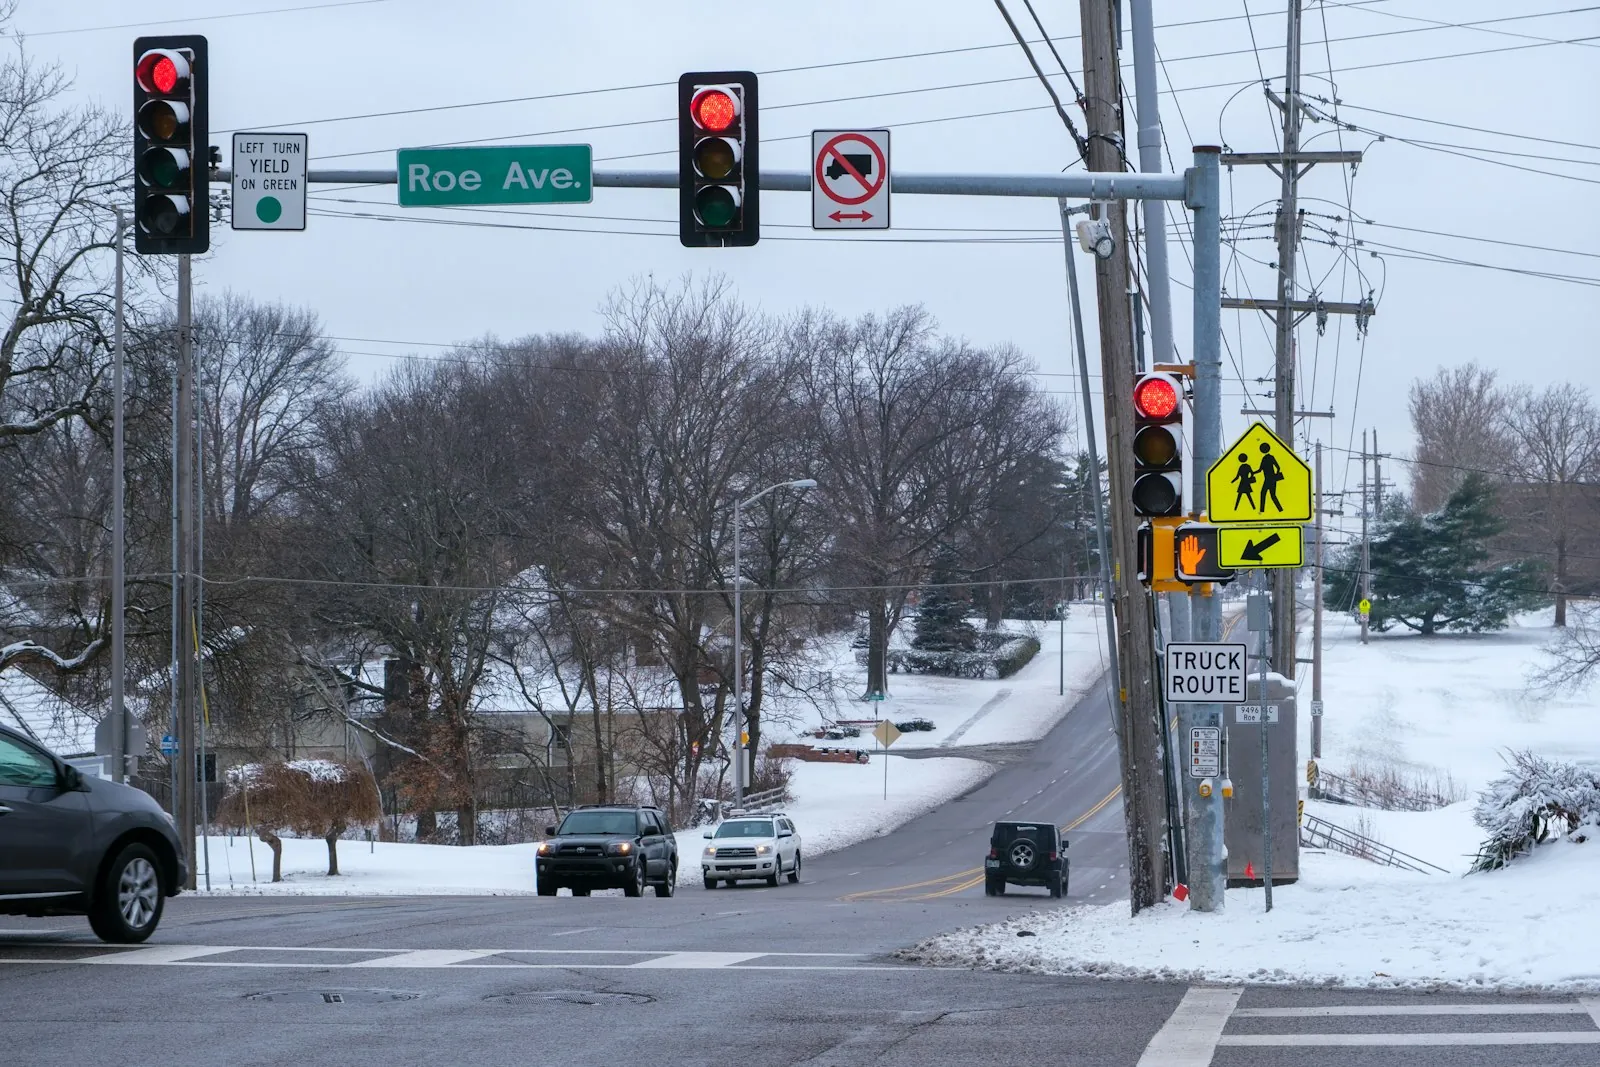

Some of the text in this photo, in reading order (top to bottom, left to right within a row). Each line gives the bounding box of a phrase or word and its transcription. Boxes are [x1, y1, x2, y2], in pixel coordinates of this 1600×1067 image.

[240, 142, 300, 154] LEFT TURN
[250, 159, 289, 173] YIELD
[408, 161, 581, 192] Roe Ave.
[241, 179, 297, 190] ON GREEN
[1172, 652, 1240, 670] TRUCK
[1173, 675, 1240, 694] ROUTE
[1240, 706, 1260, 714] 9496
